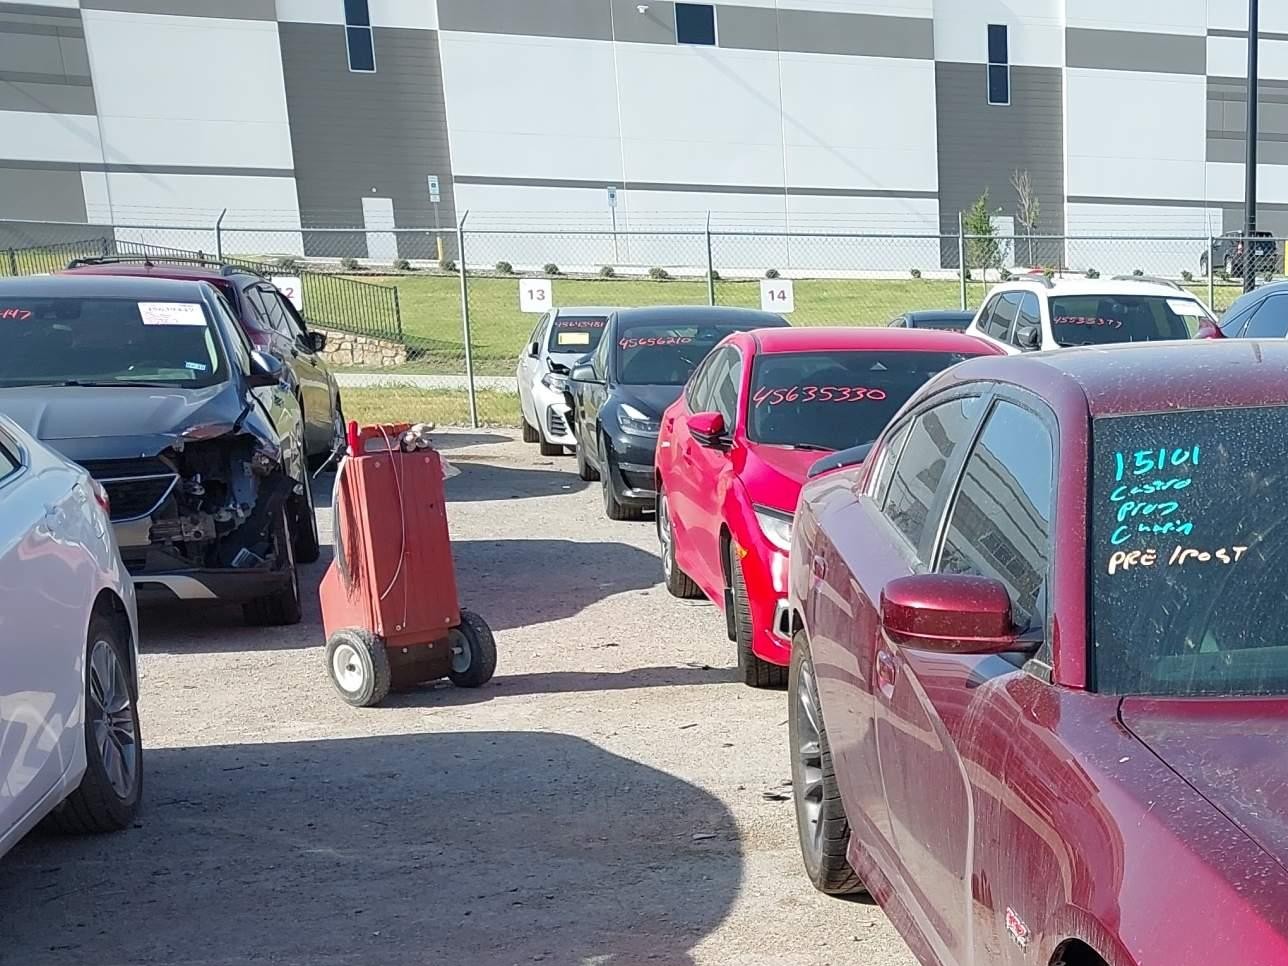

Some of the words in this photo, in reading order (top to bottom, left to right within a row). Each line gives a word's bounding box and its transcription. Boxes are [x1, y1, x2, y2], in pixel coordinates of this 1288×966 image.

[527, 289, 546, 301] 13
[767, 290, 787, 301] 14
[618, 335, 693, 350] 45656210
[752, 386, 887, 408] 45635330
[1115, 446, 1200, 481] 15101
[1108, 549, 1157, 575] PRE
